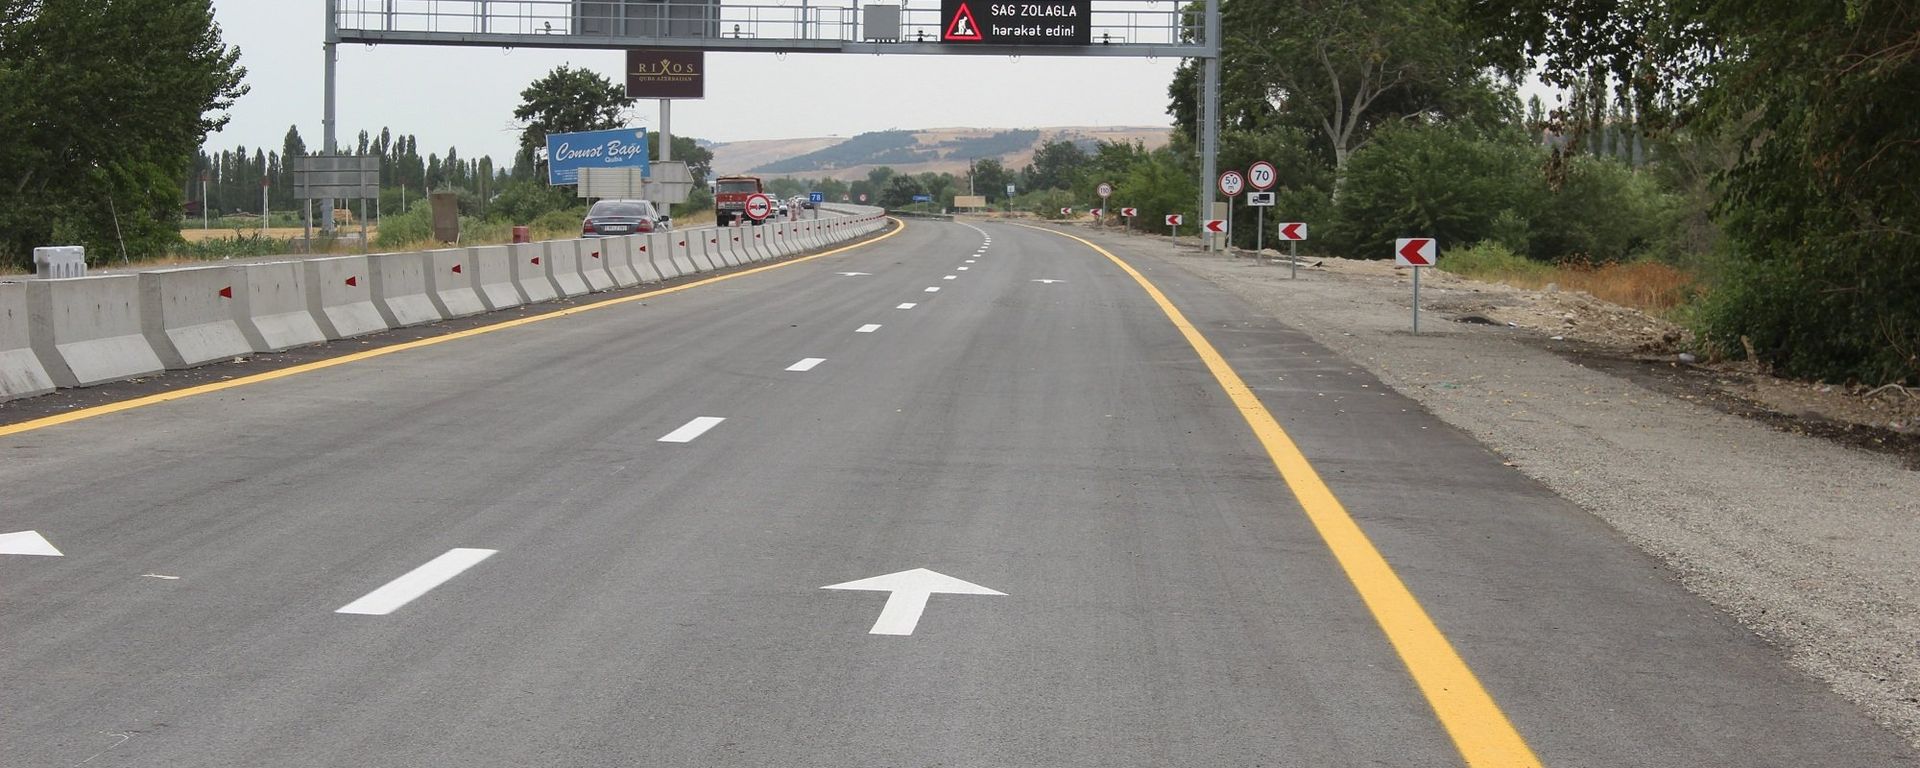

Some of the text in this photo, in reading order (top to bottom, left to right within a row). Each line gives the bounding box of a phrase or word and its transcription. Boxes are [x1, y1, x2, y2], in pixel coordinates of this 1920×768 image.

[991, 4, 1077, 17] SAG ZOLAGLA
[992, 24, 1075, 37] hərəkət edin!
[639, 60, 694, 73] RIXOS
[1255, 170, 1270, 182] 70
